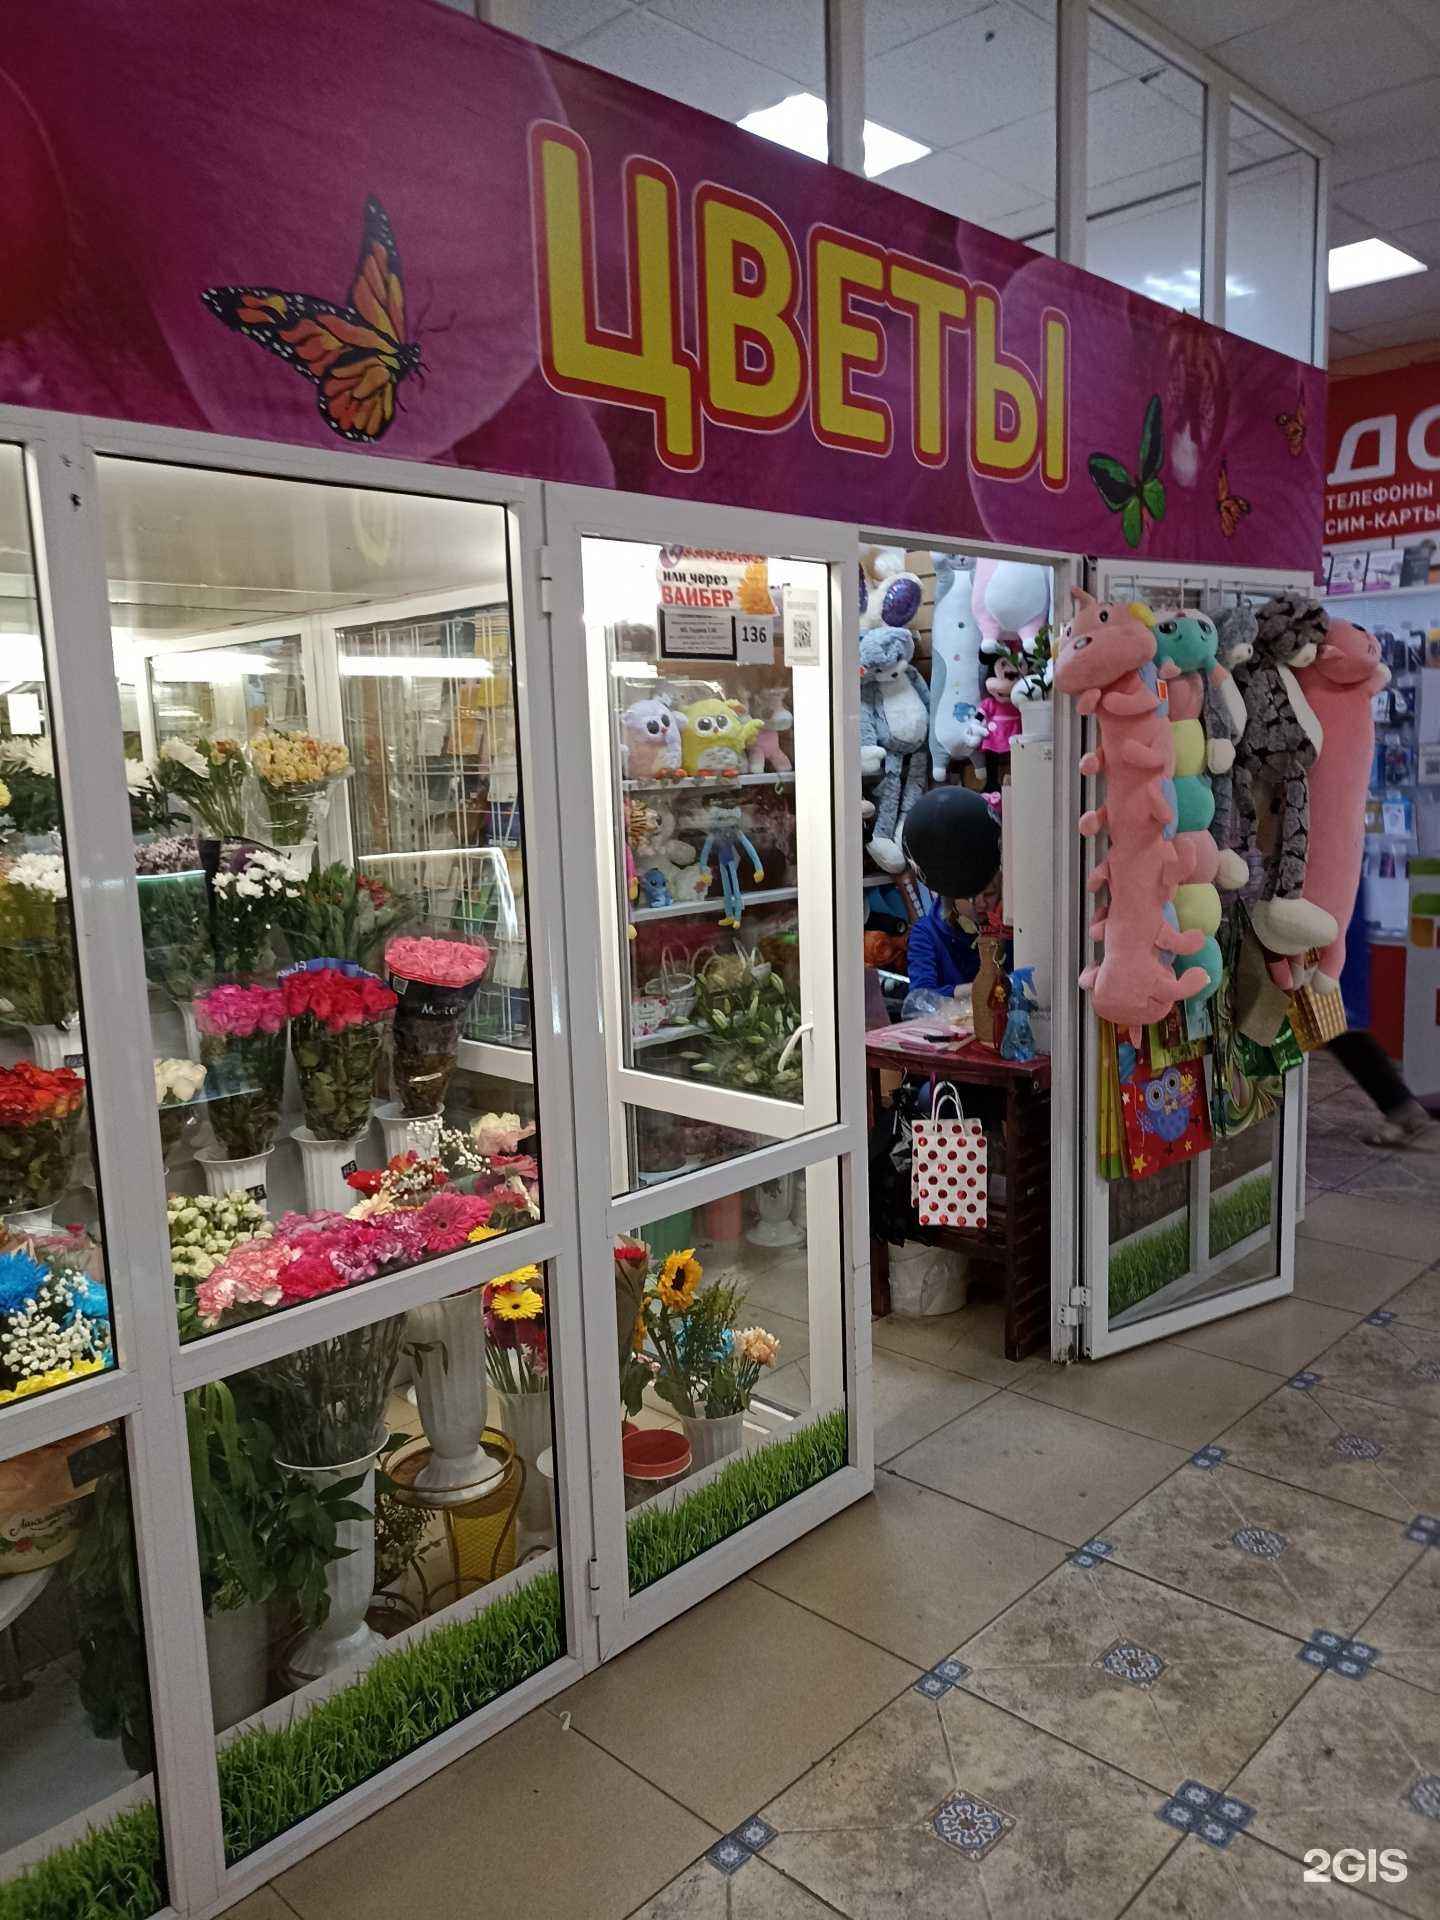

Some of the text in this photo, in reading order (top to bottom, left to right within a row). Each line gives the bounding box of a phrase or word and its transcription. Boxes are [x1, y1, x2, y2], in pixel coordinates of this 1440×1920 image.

[531, 121, 1069, 491] ЦВЕТЫ
[1327, 480, 1434, 511] ТЕЛЕФОНЫ
[1325, 504, 1440, 535] СИМ-КАРТЫ
[662, 571, 728, 588] или через
[741, 625, 767, 644] 136
